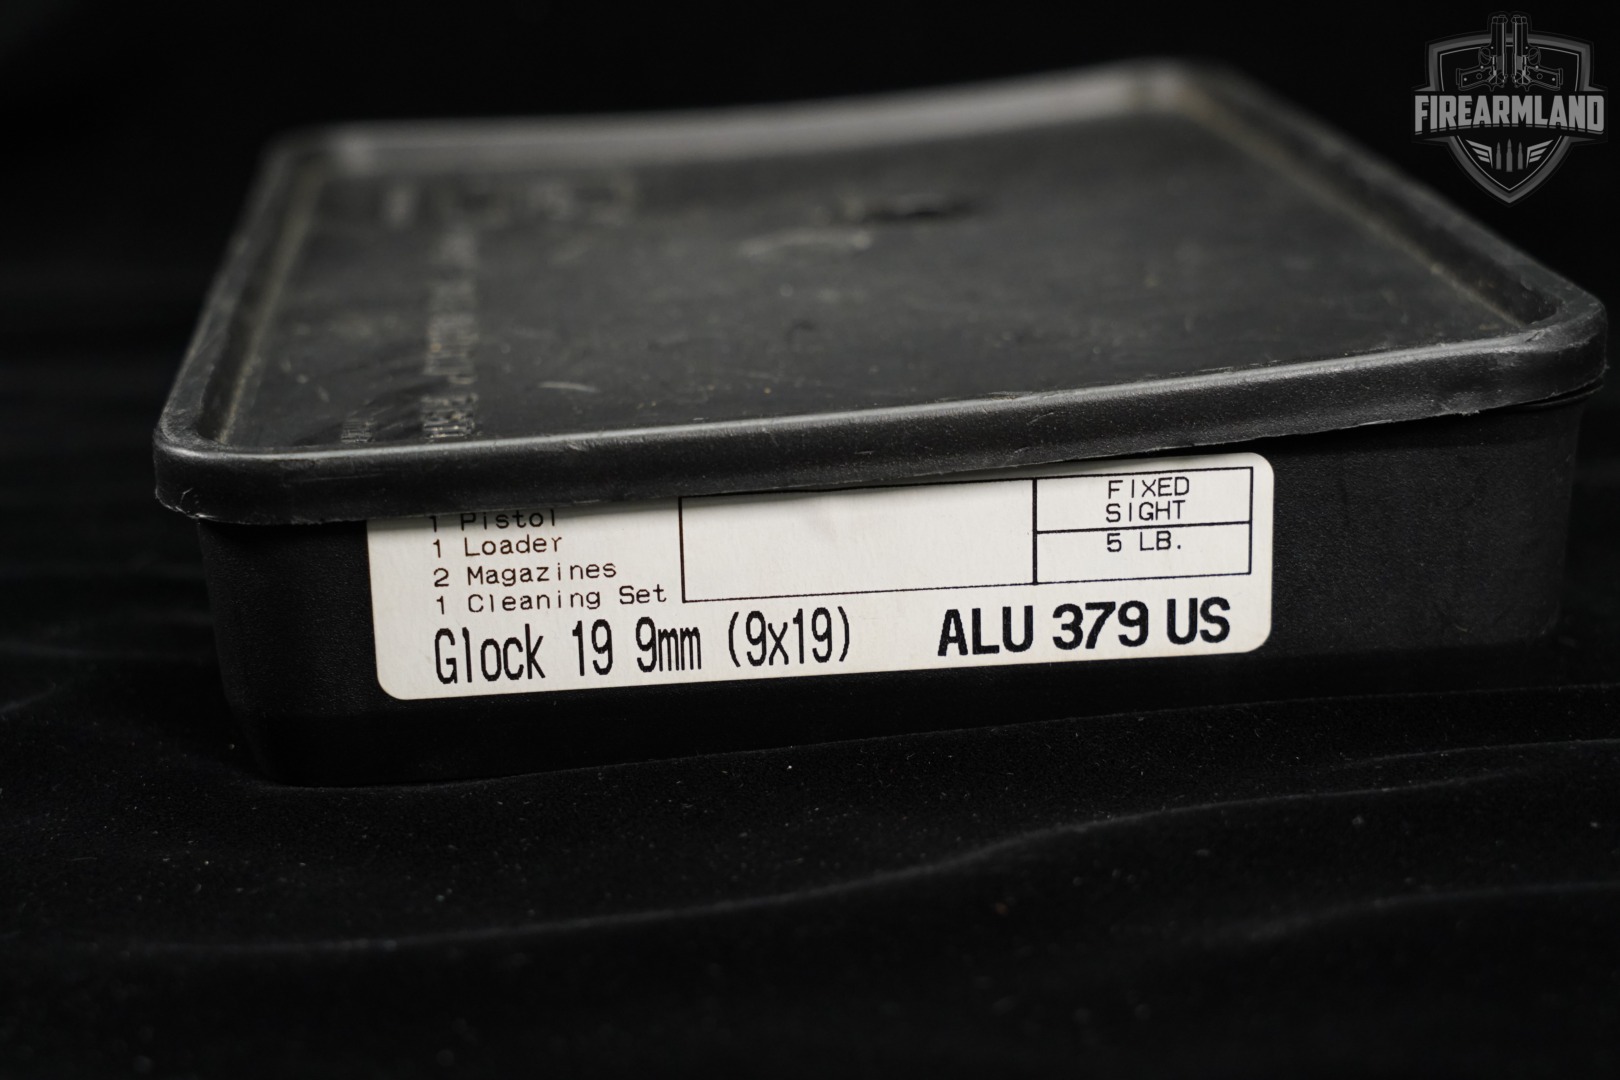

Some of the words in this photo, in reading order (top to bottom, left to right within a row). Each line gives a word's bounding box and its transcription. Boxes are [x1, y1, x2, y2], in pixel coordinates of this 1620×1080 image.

[1108, 477, 1190, 498] FIXED
[429, 515, 438, 532] 1
[460, 508, 556, 531] Pistol
[1106, 500, 1185, 522] SIGHT
[433, 538, 442, 558] 1
[464, 534, 562, 557] Loader
[1107, 532, 1122, 552] 5
[1139, 530, 1182, 551] LB.
[434, 568, 450, 587] 2
[467, 561, 617, 586] Magazines
[436, 595, 445, 615] 1
[467, 590, 600, 613] Cleaning
[619, 584, 667, 605] Set
[937, 605, 1034, 657] ALU
[1052, 600, 1149, 651] 379
[1166, 597, 1231, 644] US
[434, 623, 545, 685] Glock
[572, 619, 613, 677] 19
[636, 616, 702, 673] 9mm
[728, 606, 850, 668] (9x19)
